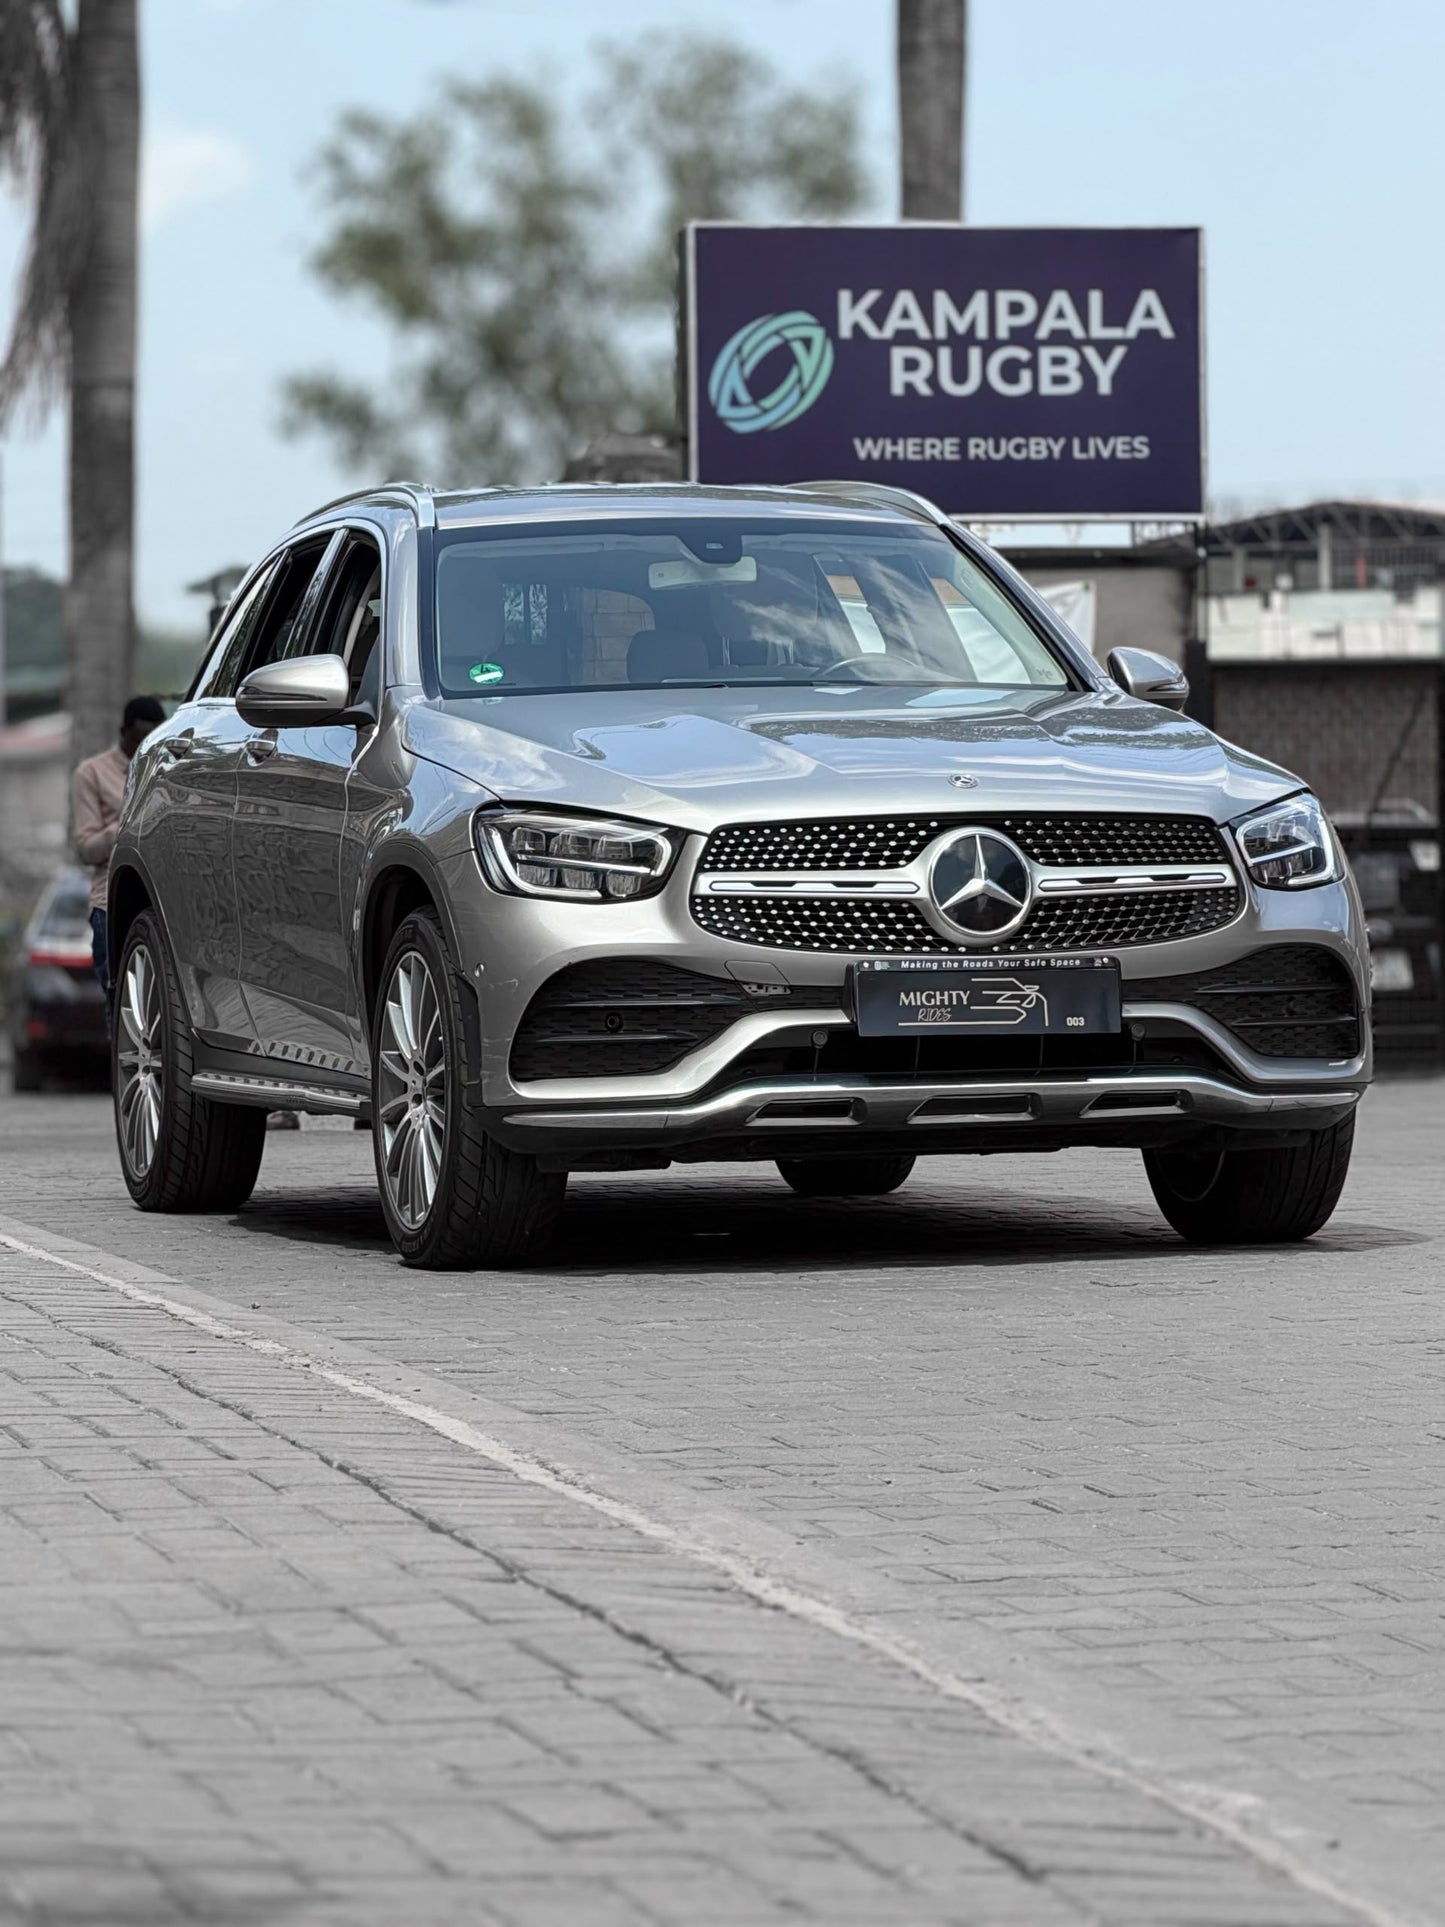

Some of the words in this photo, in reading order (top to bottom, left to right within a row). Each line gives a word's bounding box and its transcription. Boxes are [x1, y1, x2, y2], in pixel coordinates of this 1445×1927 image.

[837, 289, 1175, 340] KAMPALA
[890, 345, 1128, 397] RUGBY
[852, 437, 961, 461] WHERE
[968, 437, 1066, 461] RUGBY
[1072, 435, 1151, 460] LIVES
[901, 960, 938, 970] Making
[942, 960, 959, 968] the
[963, 959, 994, 968] Roads
[997, 959, 1020, 967] Your
[1024, 958, 1046, 967] Safe
[1050, 957, 1081, 968] Space
[899, 990, 970, 1006] MIGHTY
[1066, 1016, 1085, 1026] 003
